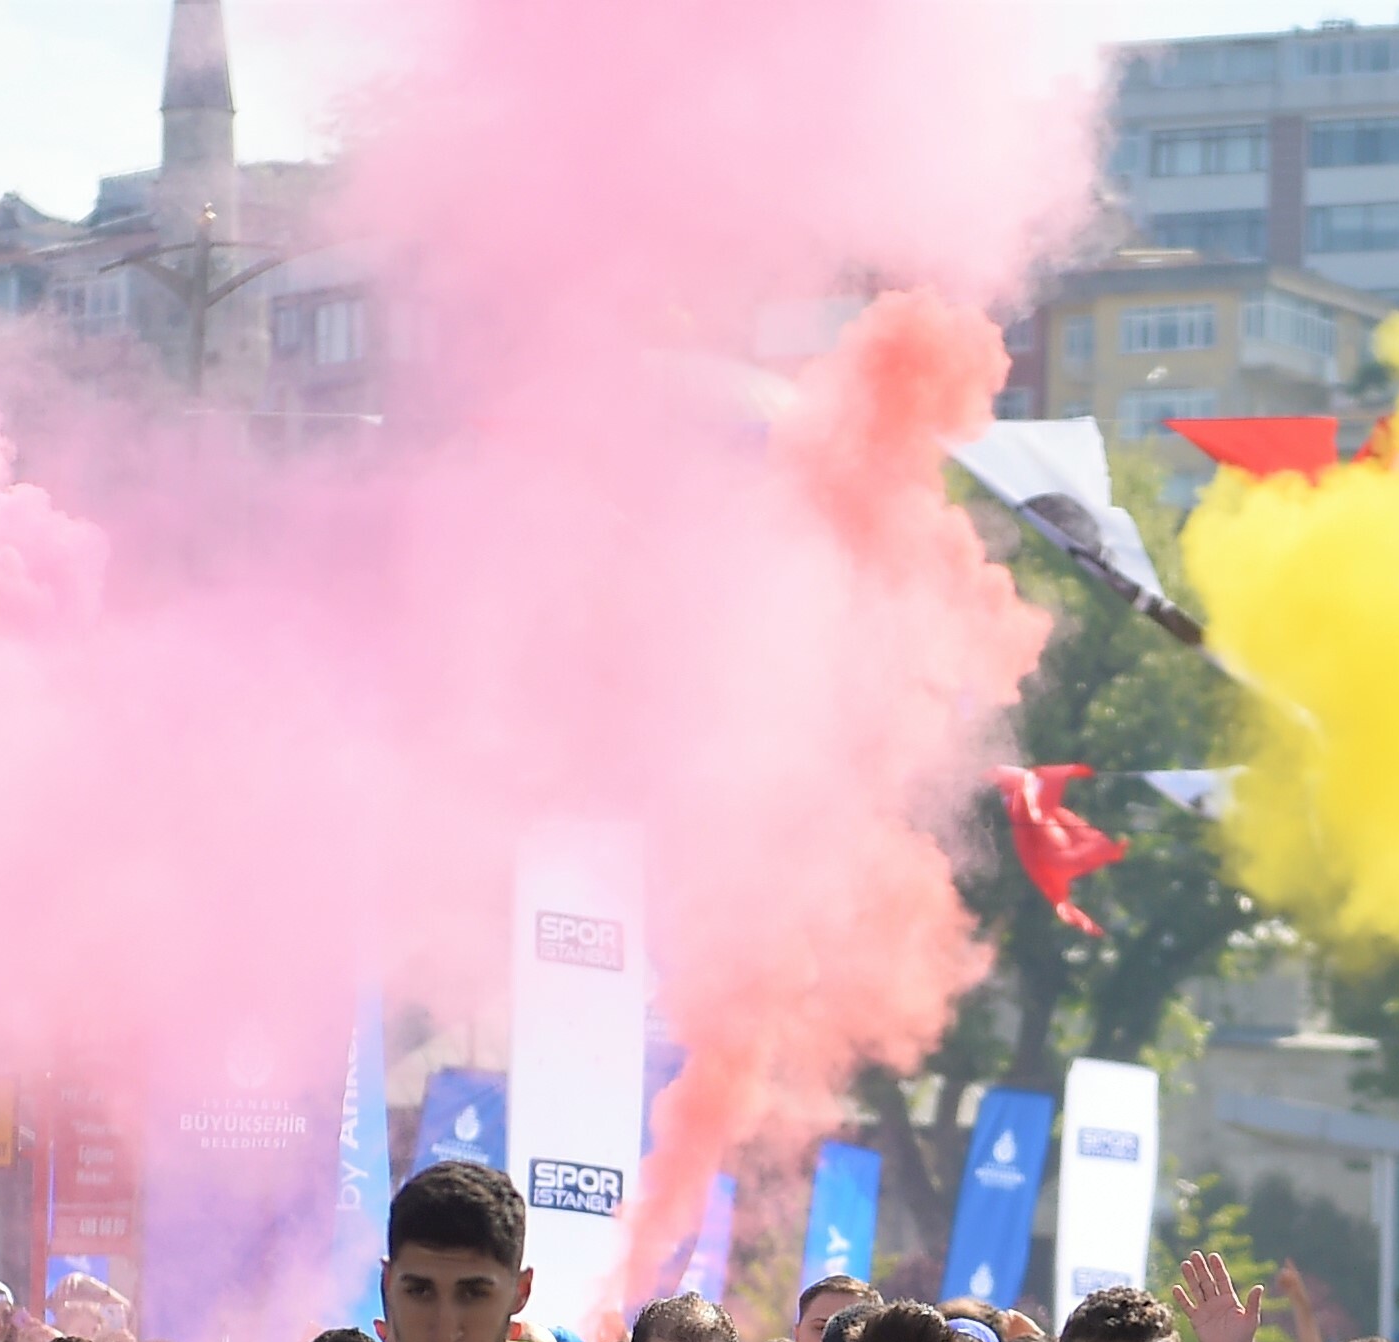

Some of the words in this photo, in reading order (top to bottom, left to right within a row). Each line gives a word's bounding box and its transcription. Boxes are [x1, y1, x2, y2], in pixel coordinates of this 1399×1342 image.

[539, 915, 616, 946] SPOR
[179, 1111, 306, 1134] BÜYÜKŞEHİR
[533, 1162, 620, 1197] SPOR
[533, 1186, 616, 1213] İSTANBU
